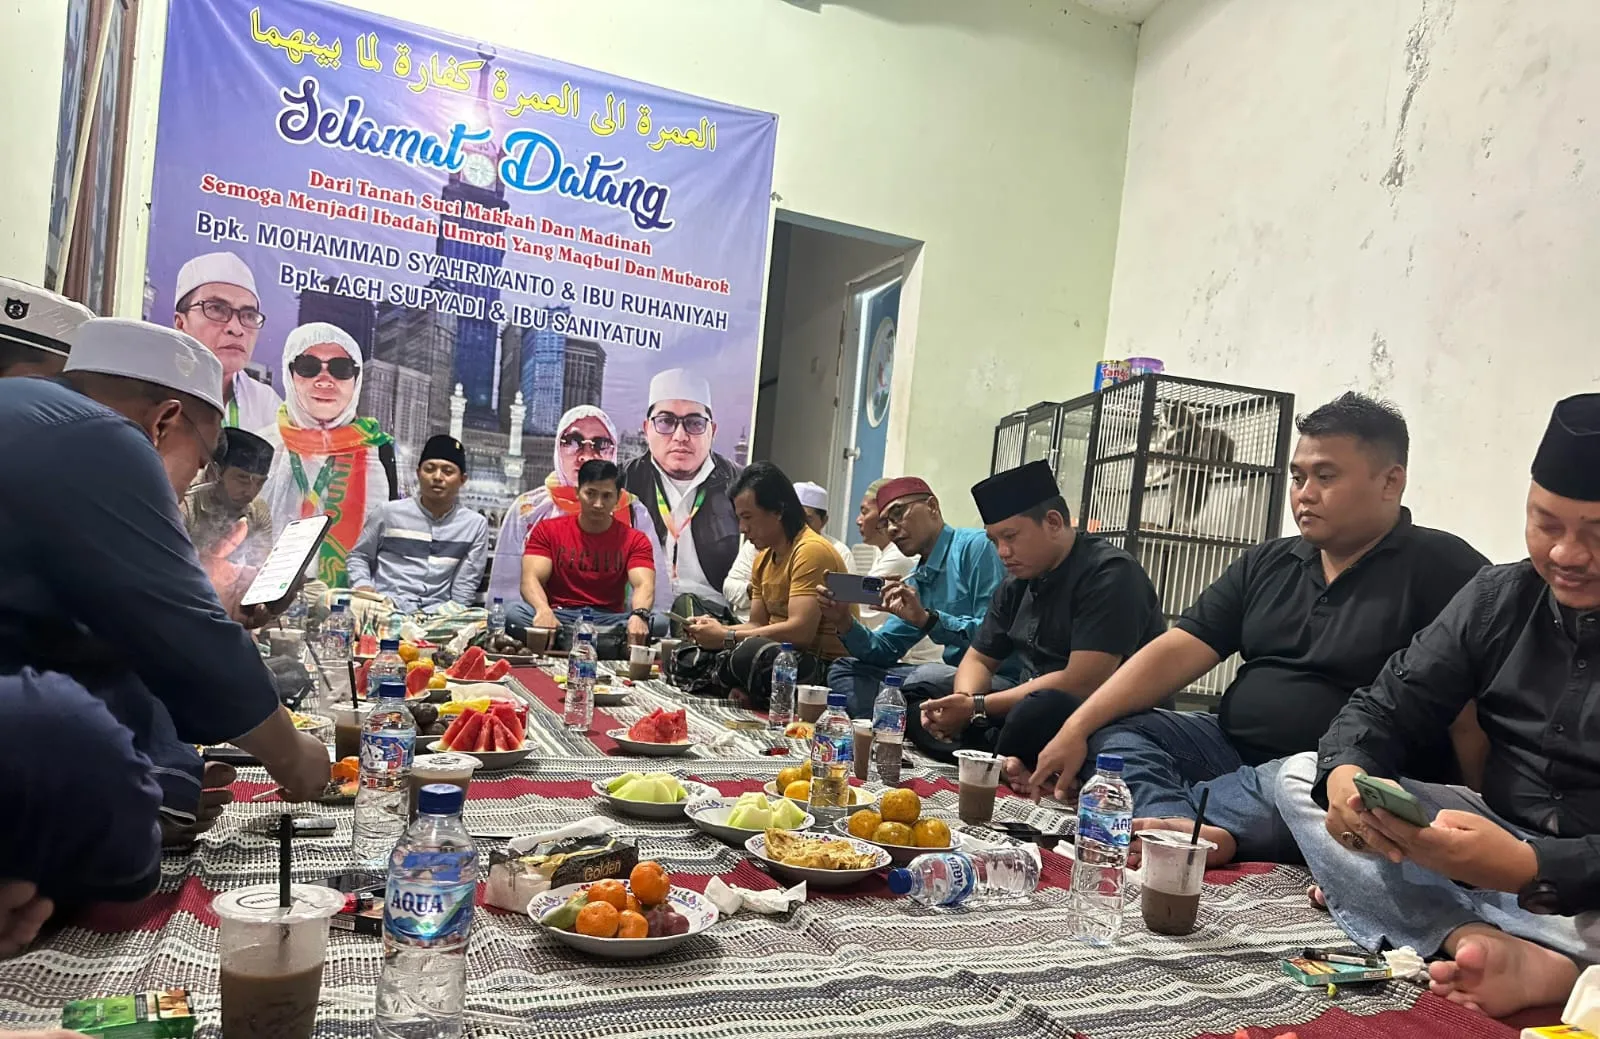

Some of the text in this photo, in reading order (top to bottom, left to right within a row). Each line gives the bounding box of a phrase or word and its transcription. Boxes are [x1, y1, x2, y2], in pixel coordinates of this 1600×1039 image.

[252, 9, 716, 150] العمرة الى العمرة كفارة لما بينهما
[279, 79, 673, 229] Selamat Datang
[201, 175, 729, 294] Semoga Menjadi Ibadah Umroh Yang Maqbul Dan Mubarok
[310, 171, 652, 256] Dari Tanah Suci Makkah Dan Madinah
[197, 212, 728, 330] Bpk. MOHAMMAD SYAHRIYANTO & IBU RUHANIYAH
[280, 265, 661, 350] Bpk. ACH SUPYADI & IBU SANIYATUN
[391, 889, 444, 917] AQUA
[584, 861, 621, 881] Golden
[947, 856, 964, 887] AQUA
